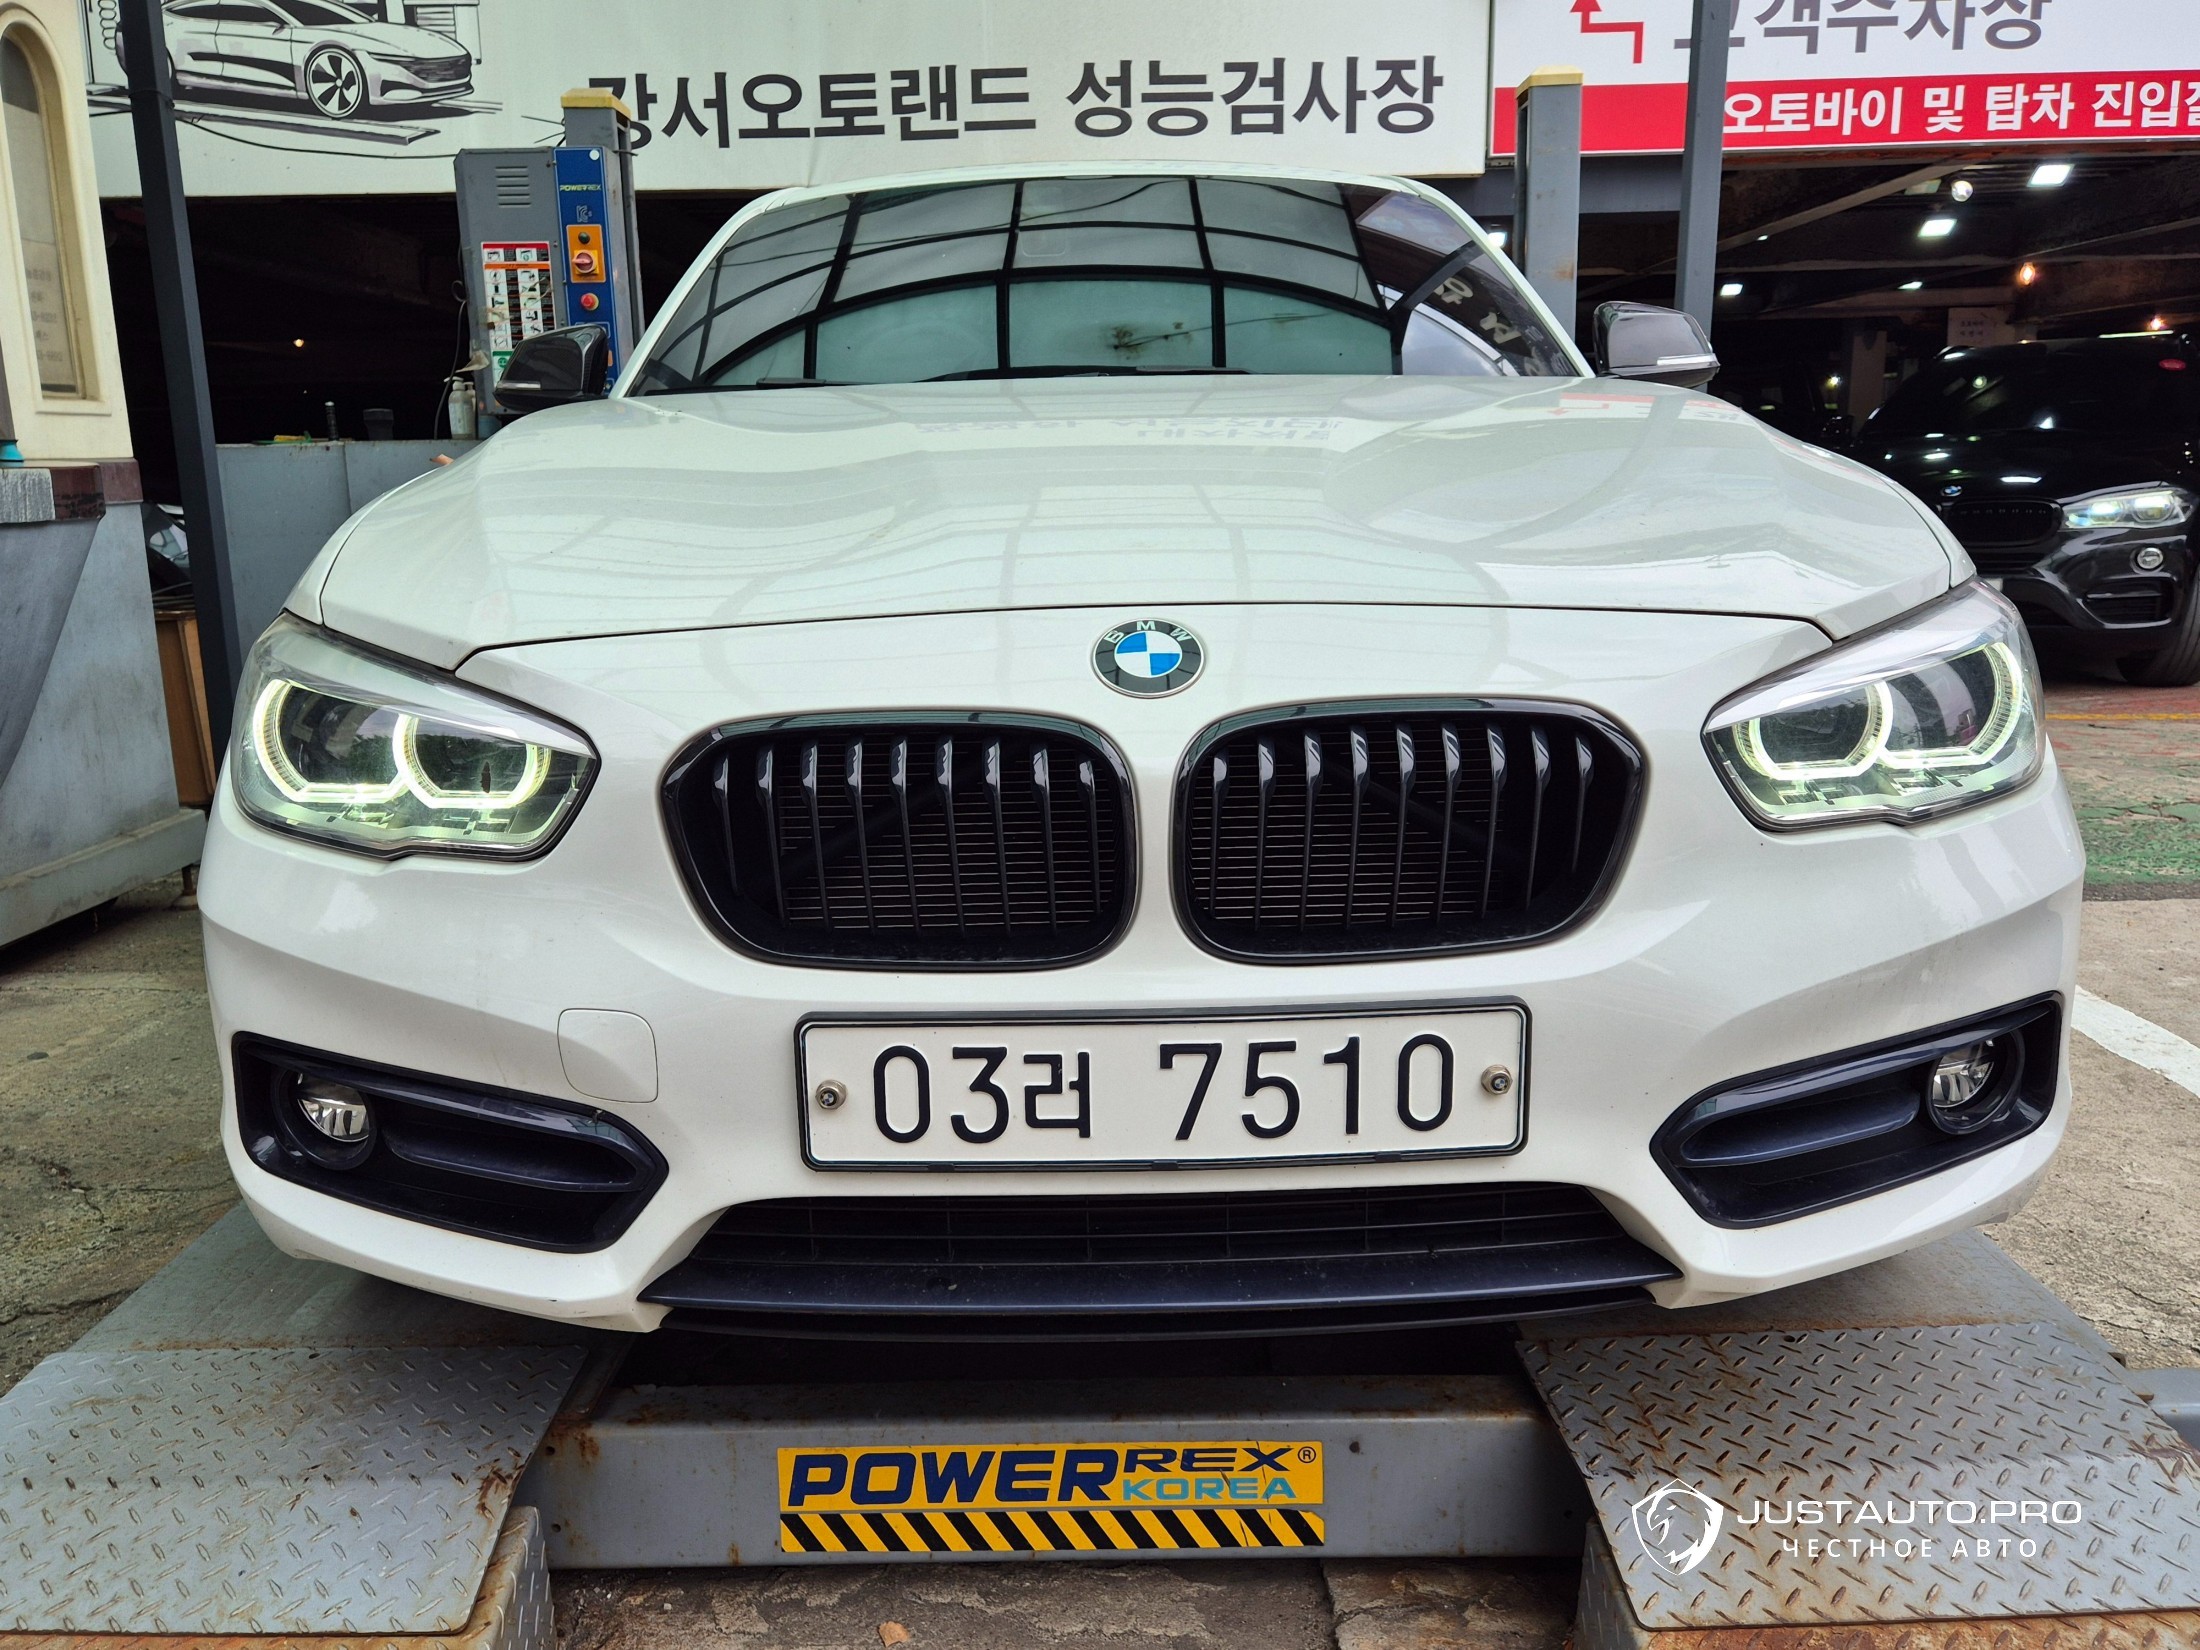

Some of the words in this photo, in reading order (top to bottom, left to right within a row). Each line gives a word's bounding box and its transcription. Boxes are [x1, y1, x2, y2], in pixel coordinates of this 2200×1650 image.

[588, 64, 1037, 149] 강서오토랜드
[1066, 55, 1444, 138] 성능검사장
[1723, 86, 1903, 136] 오토바이
[1923, 84, 1965, 133] 및
[1985, 82, 2075, 131] 탑차
[1103, 620, 1192, 644] BMW
[872, 1045, 1092, 1144] 03러
[1158, 1033, 1454, 1141] 7510
[1122, 1478, 1298, 1500] KOREA
